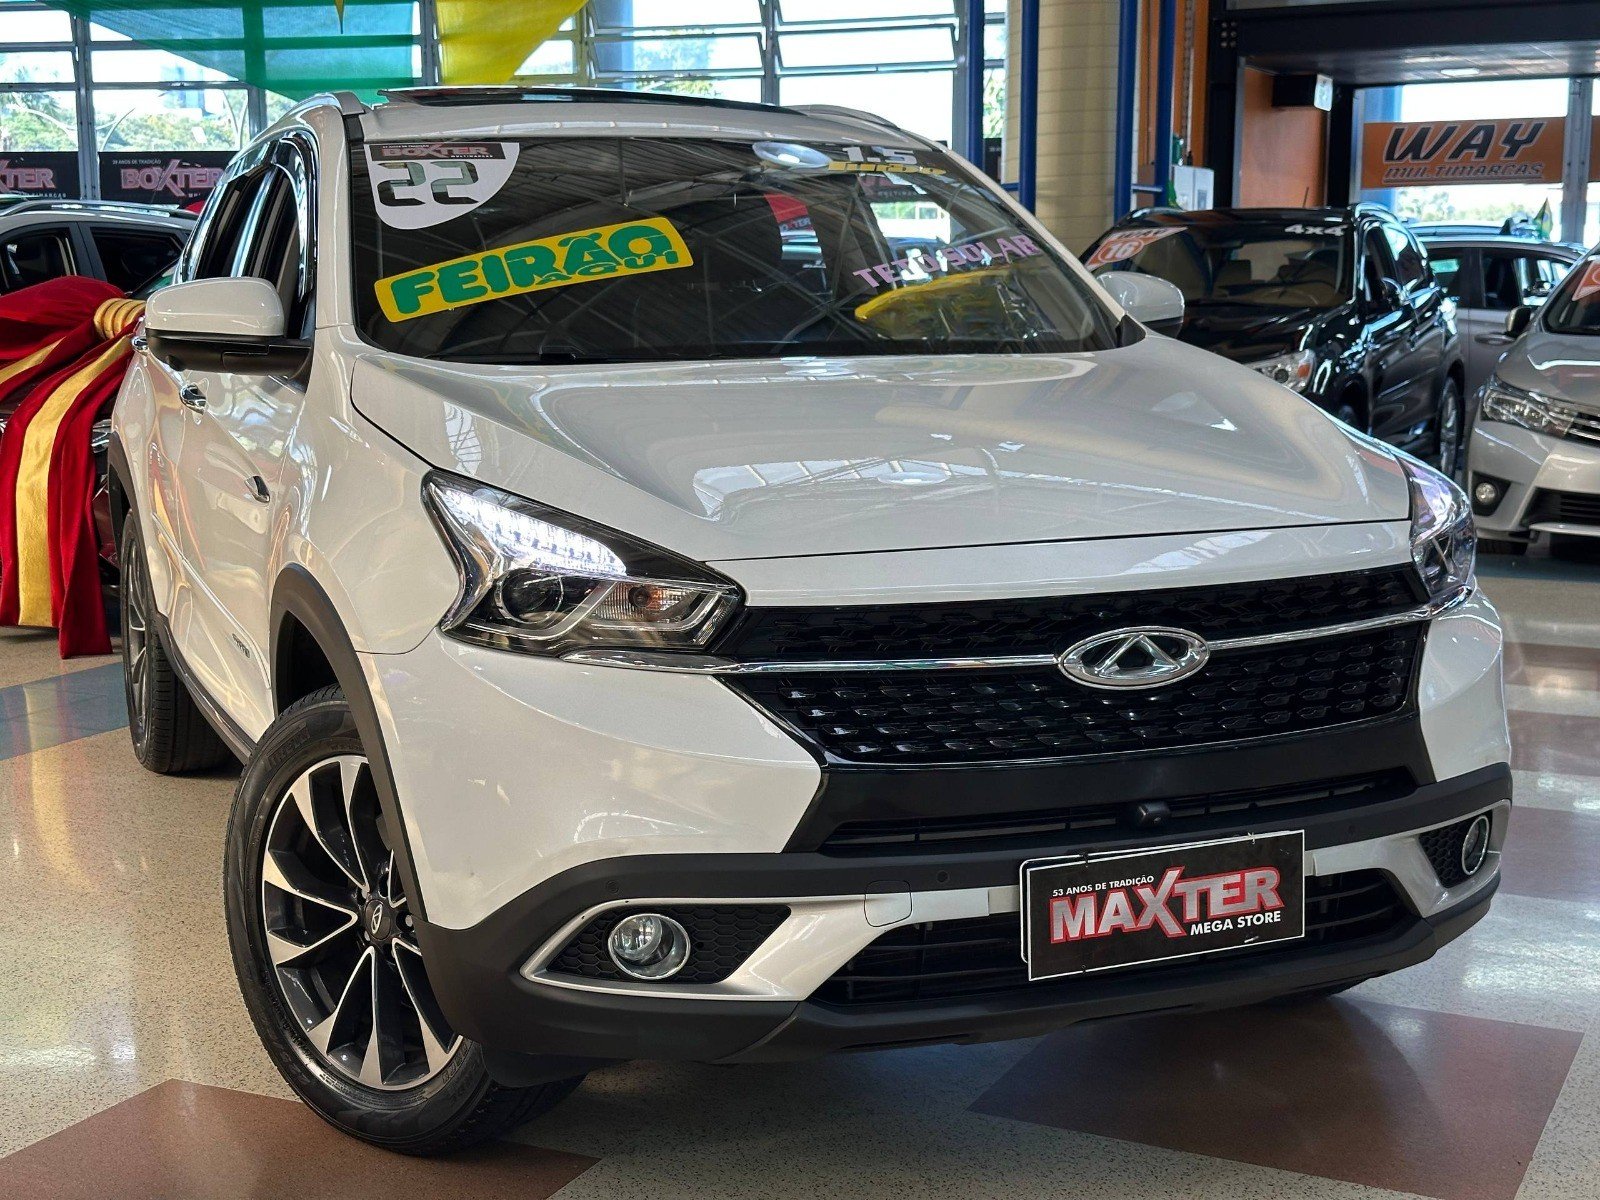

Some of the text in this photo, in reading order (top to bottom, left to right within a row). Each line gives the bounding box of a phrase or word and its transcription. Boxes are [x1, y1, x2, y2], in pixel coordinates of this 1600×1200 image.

[381, 144, 489, 158] BOXTER
[1383, 121, 1546, 162] WAY
[377, 161, 479, 207] 22
[1384, 163, 1545, 179] MULTIMARCAS
[1284, 224, 1348, 237] 4x4
[853, 234, 1041, 288] TETO SOLAR
[1103, 241, 1140, 259] 16
[390, 225, 674, 314] FEIRÃO
[1052, 875, 1155, 897] 53 ANOS DE TRADIÇÃO
[1050, 866, 1285, 944] MAXTER
[1190, 910, 1281, 936] MEGA STORE
